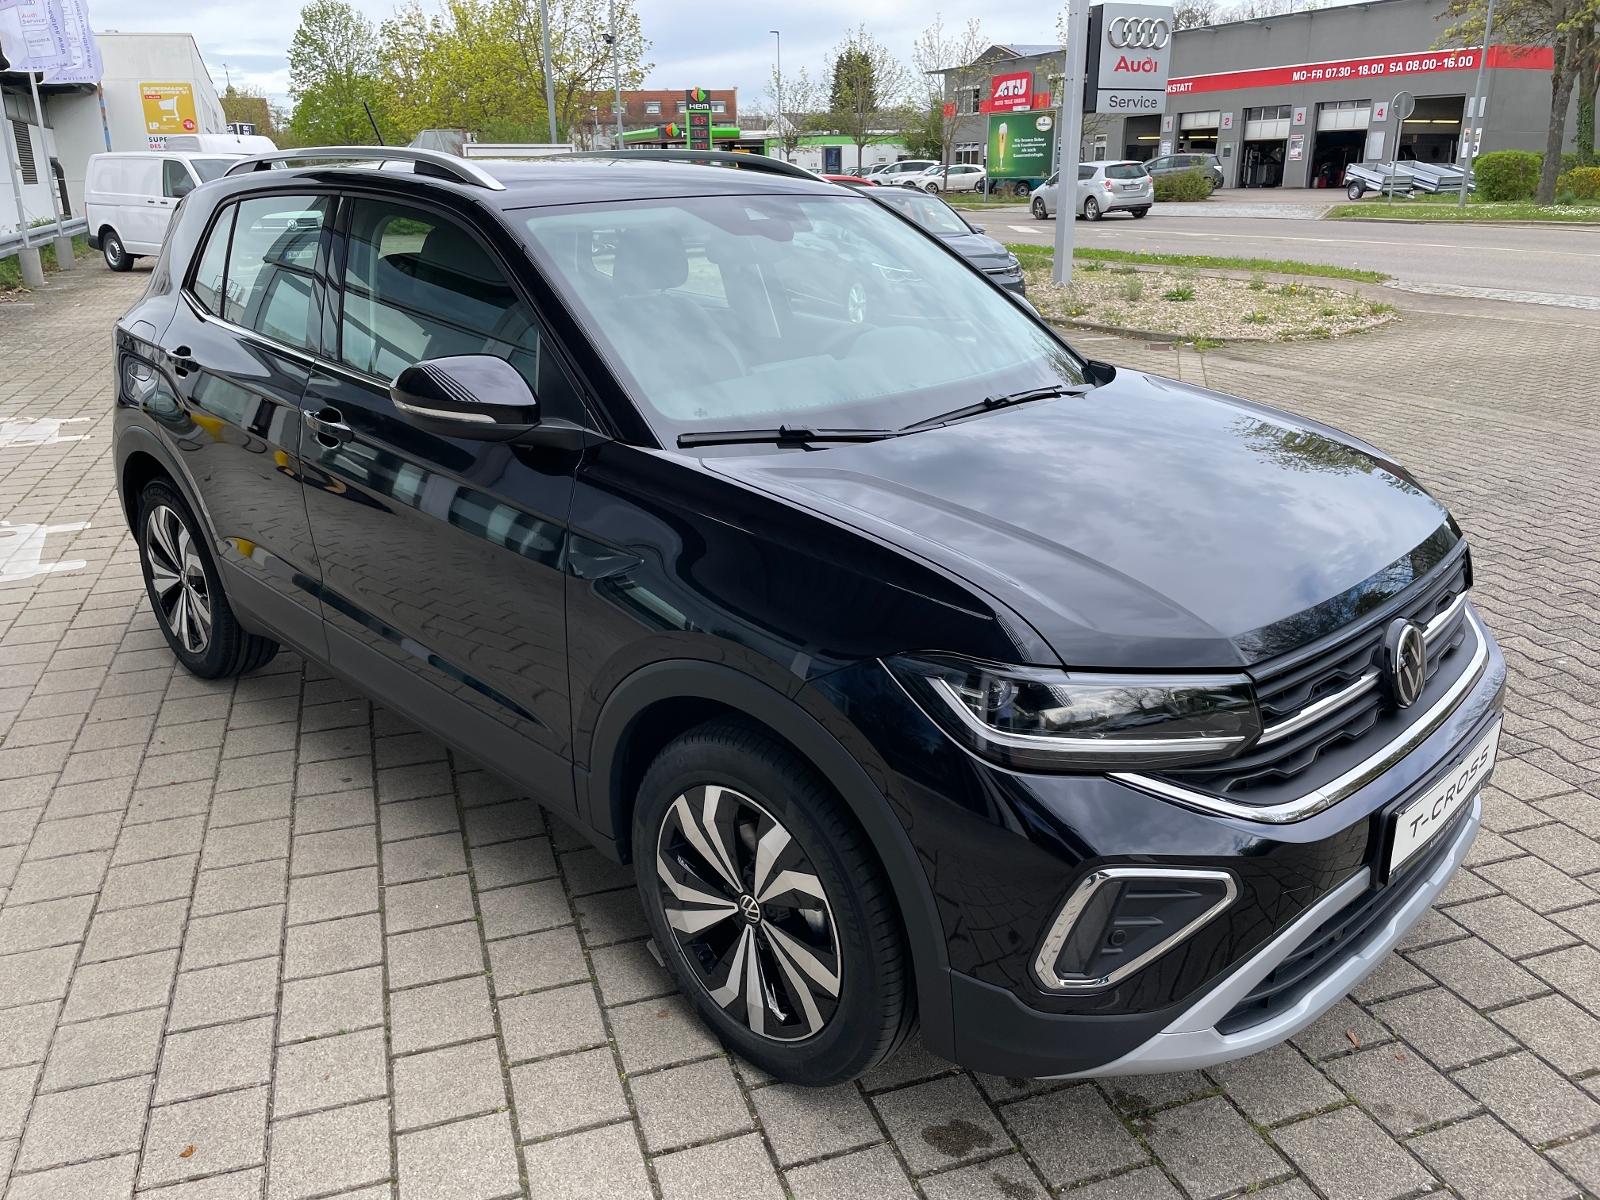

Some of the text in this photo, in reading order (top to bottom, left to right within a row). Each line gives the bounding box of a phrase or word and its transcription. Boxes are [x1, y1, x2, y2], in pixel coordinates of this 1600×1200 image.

[1113, 55, 1158, 73] Audi
[1292, 69, 1323, 81] MO-FR
[1389, 61, 1403, 73] SA
[1109, 95, 1158, 108] Service
[1297, 113, 1303, 122] 3
[1377, 108, 1384, 118] 4
[1166, 121, 1171, 129] 1
[1224, 117, 1230, 126] 2
[1409, 744, 1491, 838] T-CROSS
